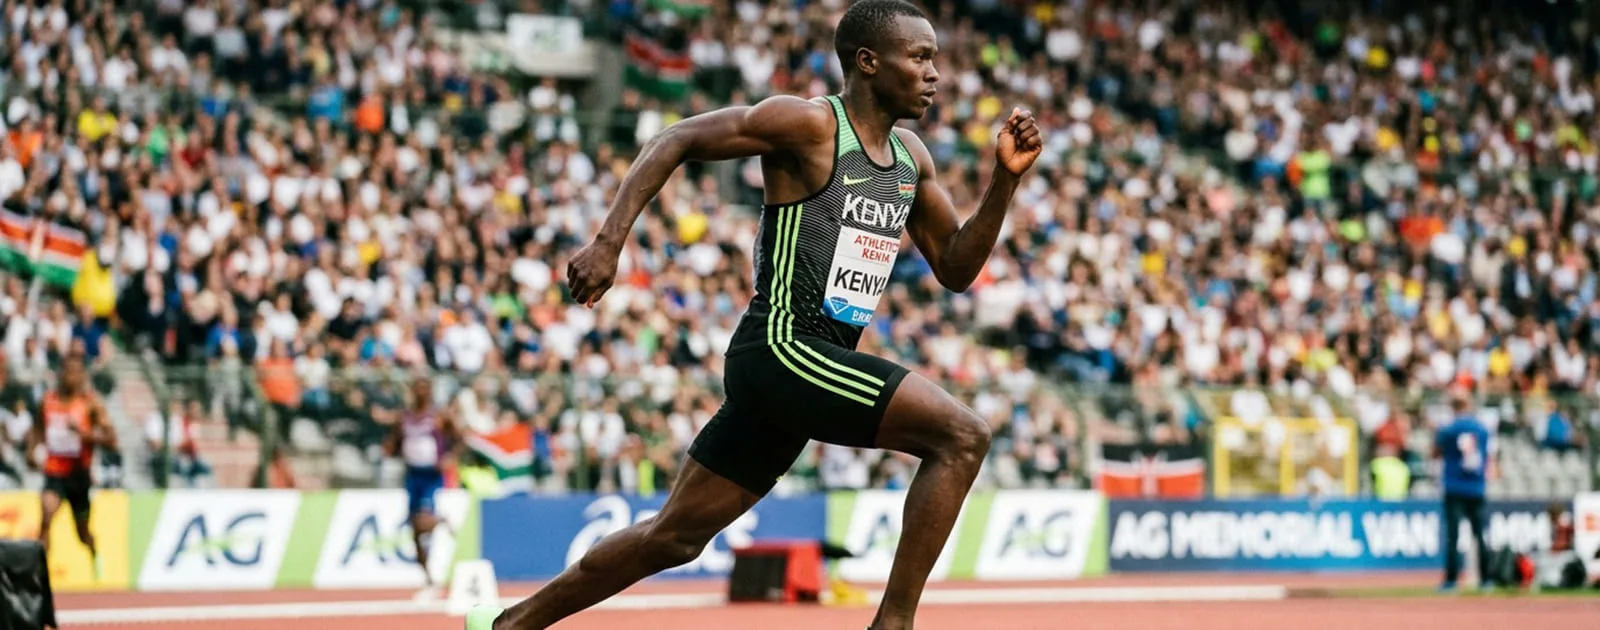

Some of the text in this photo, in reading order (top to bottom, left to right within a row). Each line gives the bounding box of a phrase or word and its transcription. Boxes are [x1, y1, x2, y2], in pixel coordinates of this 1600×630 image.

[841, 193, 909, 230] KENYA
[834, 267, 886, 296] KENYA
[166, 511, 268, 567] AG
[997, 510, 1073, 558] AG
[1111, 511, 1168, 558] AG
[1171, 511, 1363, 558] MEMORIAL
[1361, 511, 1439, 557] VAN
